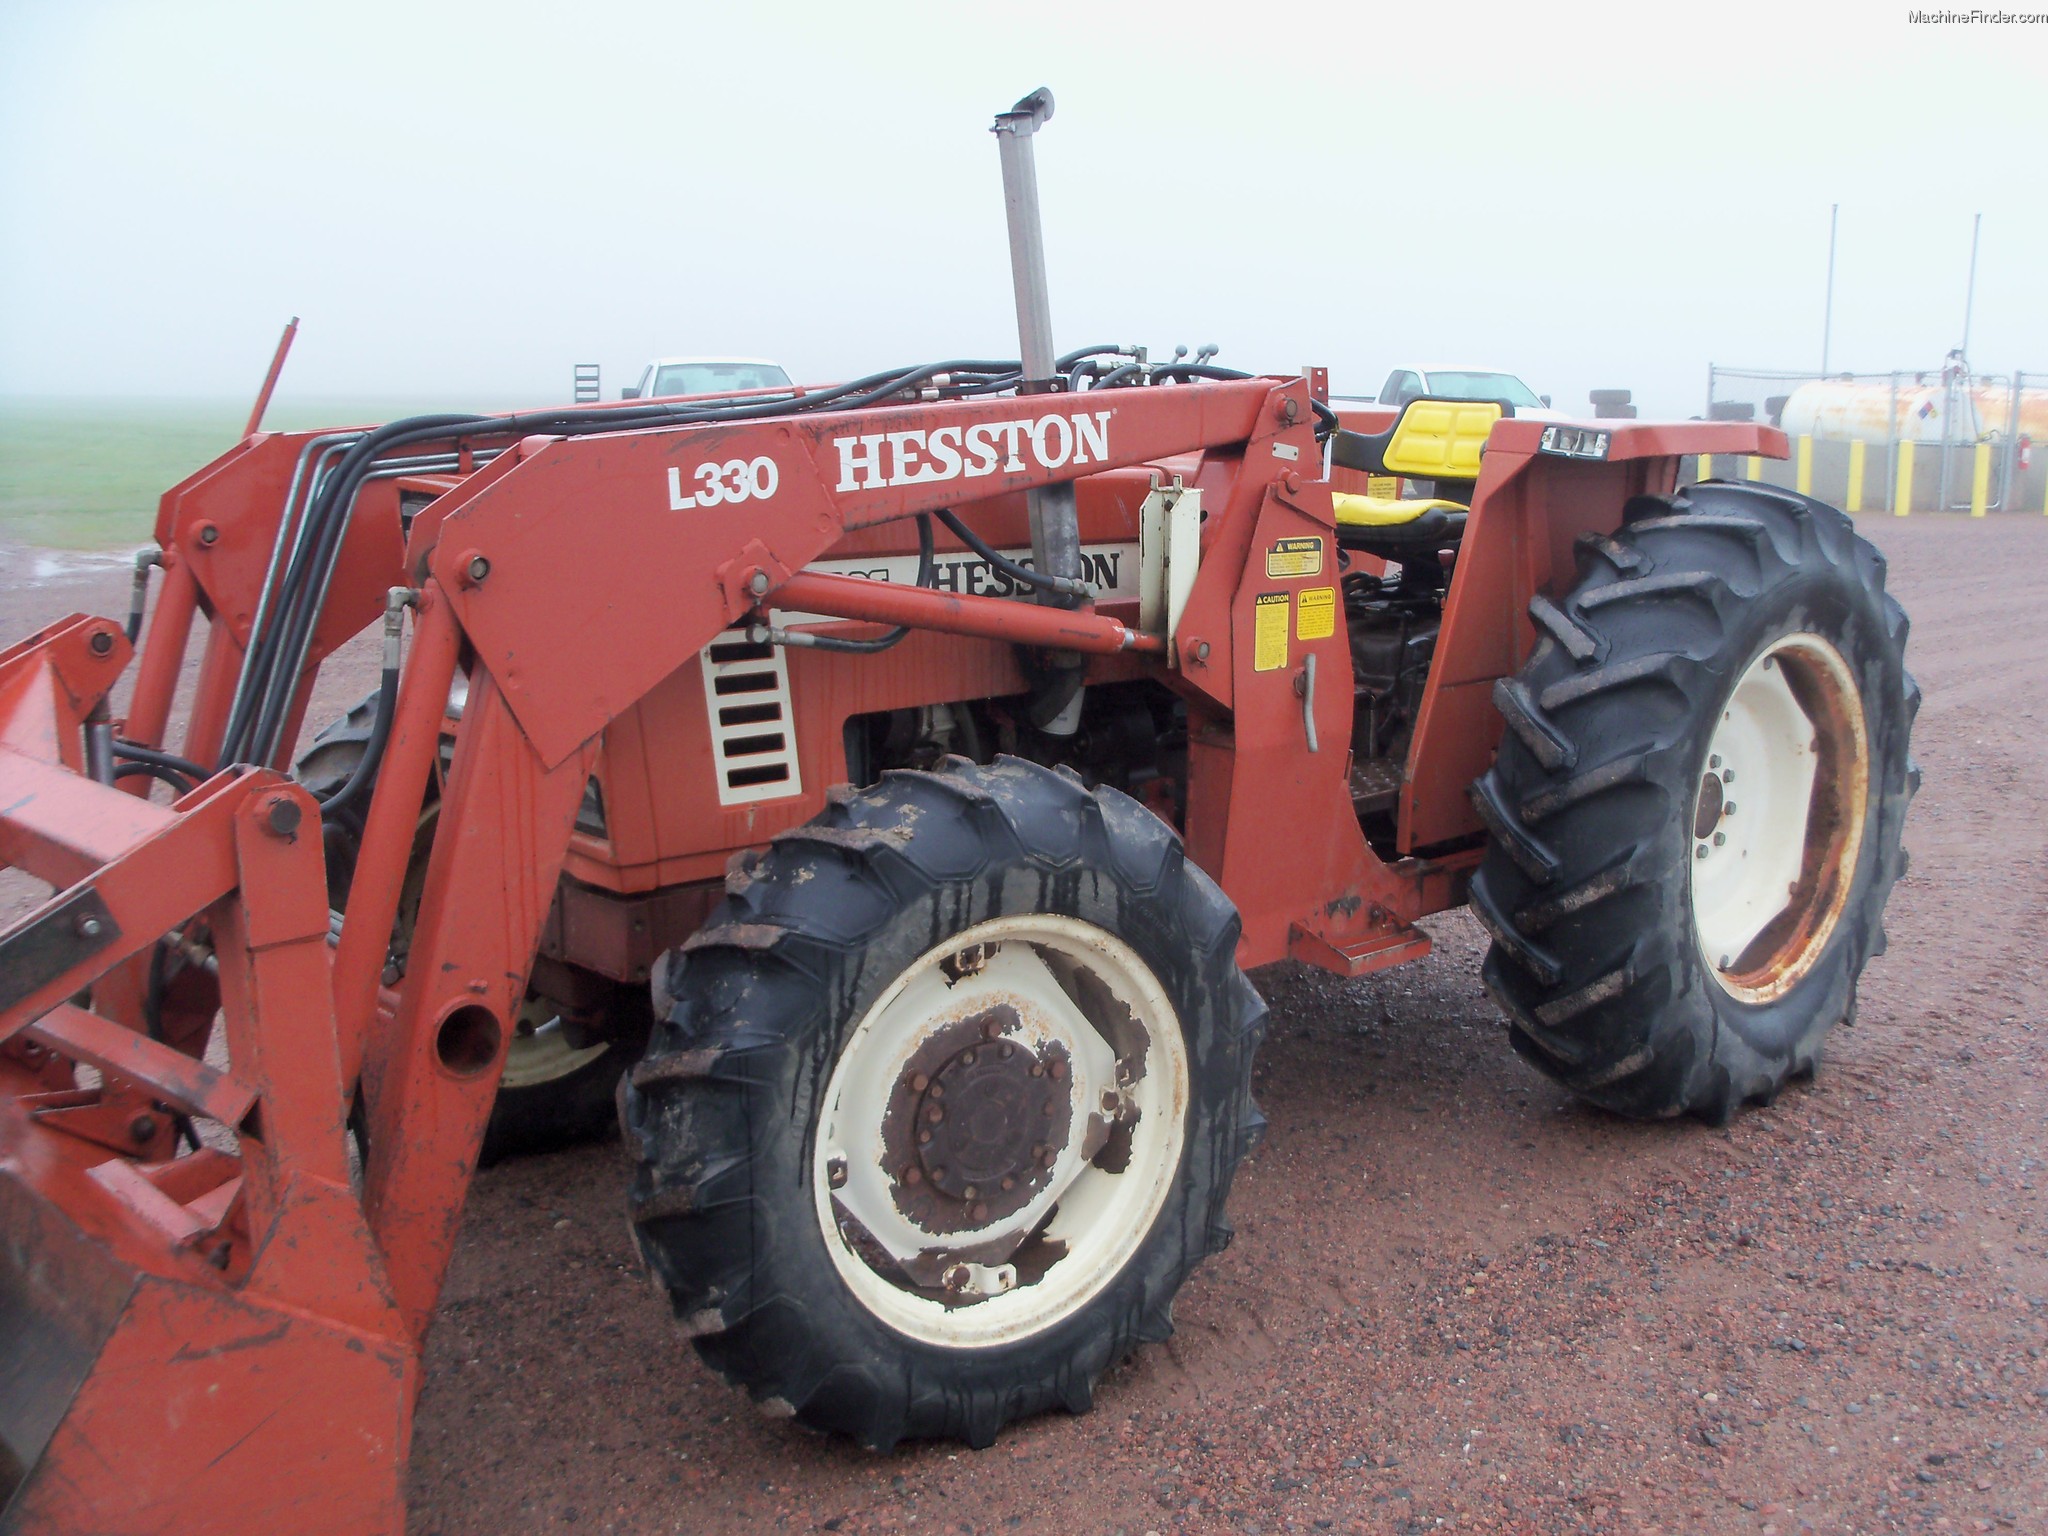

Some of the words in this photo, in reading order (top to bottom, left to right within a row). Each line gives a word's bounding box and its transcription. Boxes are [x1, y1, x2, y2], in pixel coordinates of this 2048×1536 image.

[833, 411, 1112, 493] HESSTON
[667, 455, 779, 511] L330
[1287, 541, 1314, 551] WARNING
[1263, 594, 1289, 604] CAUTION
[1308, 594, 1332, 602] WARNING
